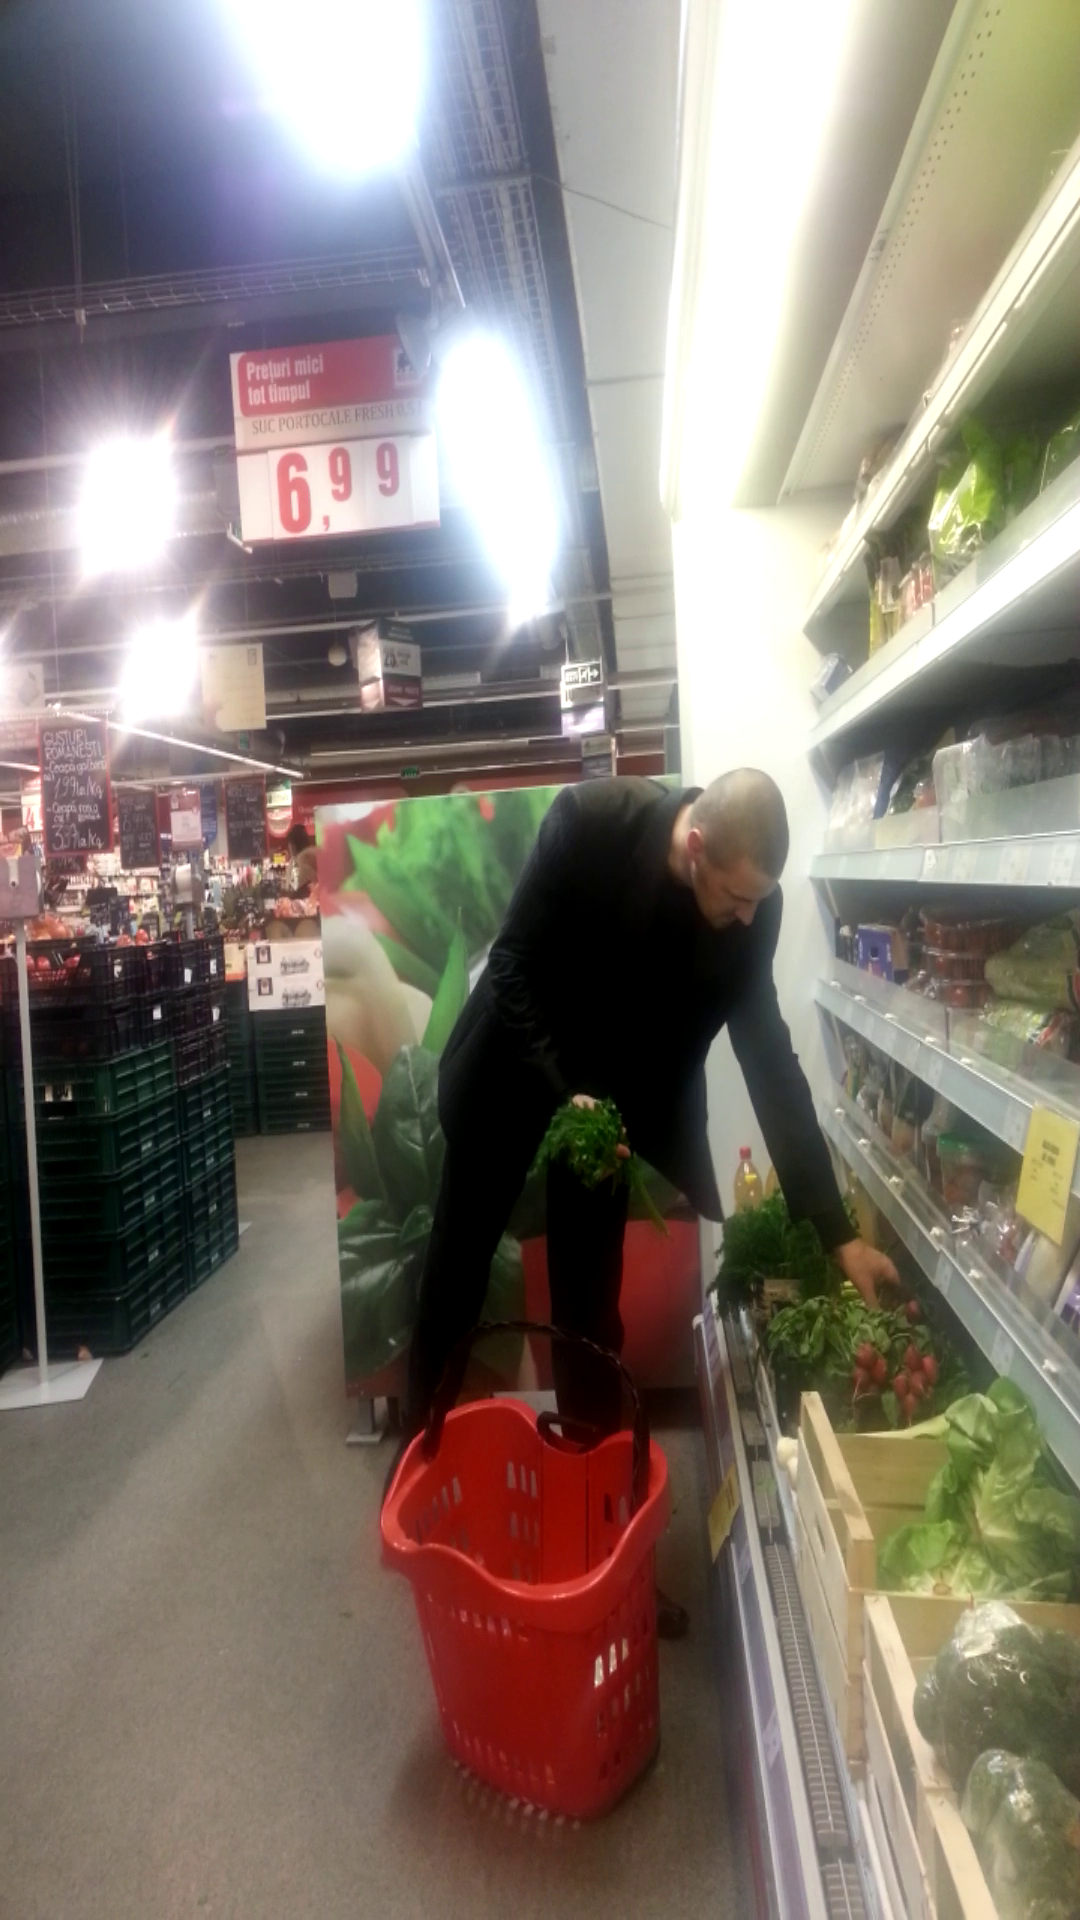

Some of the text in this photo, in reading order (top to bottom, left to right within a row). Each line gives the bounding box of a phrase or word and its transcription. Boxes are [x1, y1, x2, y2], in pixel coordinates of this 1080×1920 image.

[294, 353, 324, 377] mici
[248, 379, 311, 406] tot timpul
[251, 418, 276, 436] SUC
[278, 408, 352, 432] PORTOCALE
[355, 403, 394, 423] FRESH
